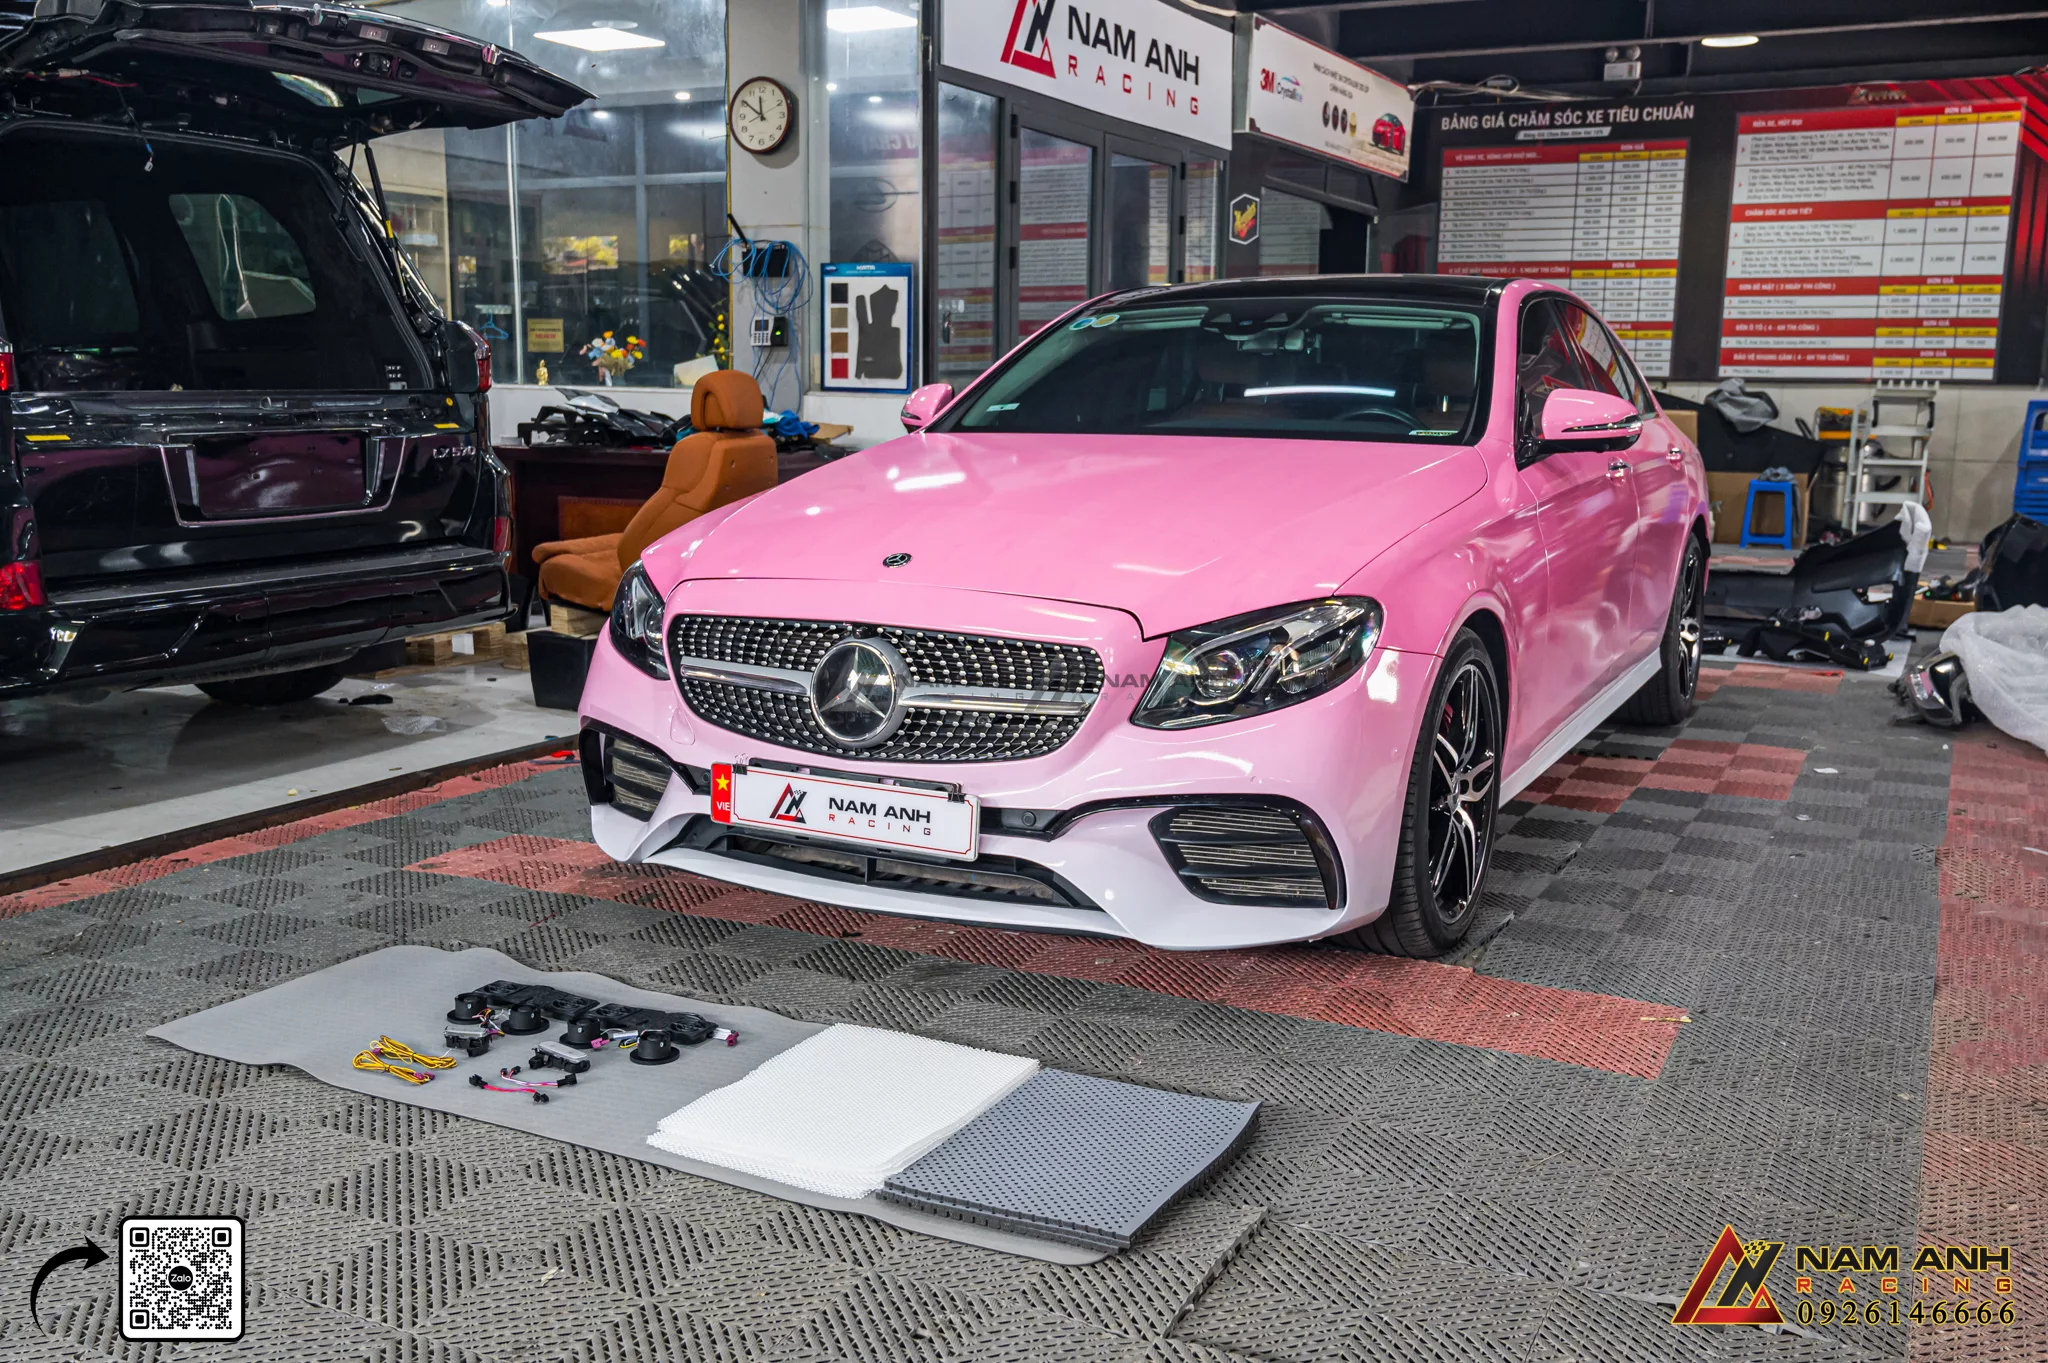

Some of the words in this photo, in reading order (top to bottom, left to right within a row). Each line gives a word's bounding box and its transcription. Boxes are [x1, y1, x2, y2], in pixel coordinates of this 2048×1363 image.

[1068, 4, 1136, 63] NAM
[1144, 38, 1199, 86] ANH
[758, 86, 766, 94] 12
[1067, 54, 1199, 115] RACING
[1260, 68, 1275, 94] 3M
[1441, 114, 1478, 131] BẢNG
[1482, 111, 1505, 128] GIÁ
[1509, 110, 1550, 127] CHĂM
[1554, 109, 1582, 125] SÓC
[1586, 109, 1604, 124] XE
[1608, 106, 1638, 123] TIÊU
[1643, 101, 1695, 121] CHUẨN
[758, 138, 765, 146] 6
[452, 446, 476, 457] 570
[829, 797, 877, 817] NAM
[884, 805, 931, 824] ANH
[829, 813, 932, 836] RACING
